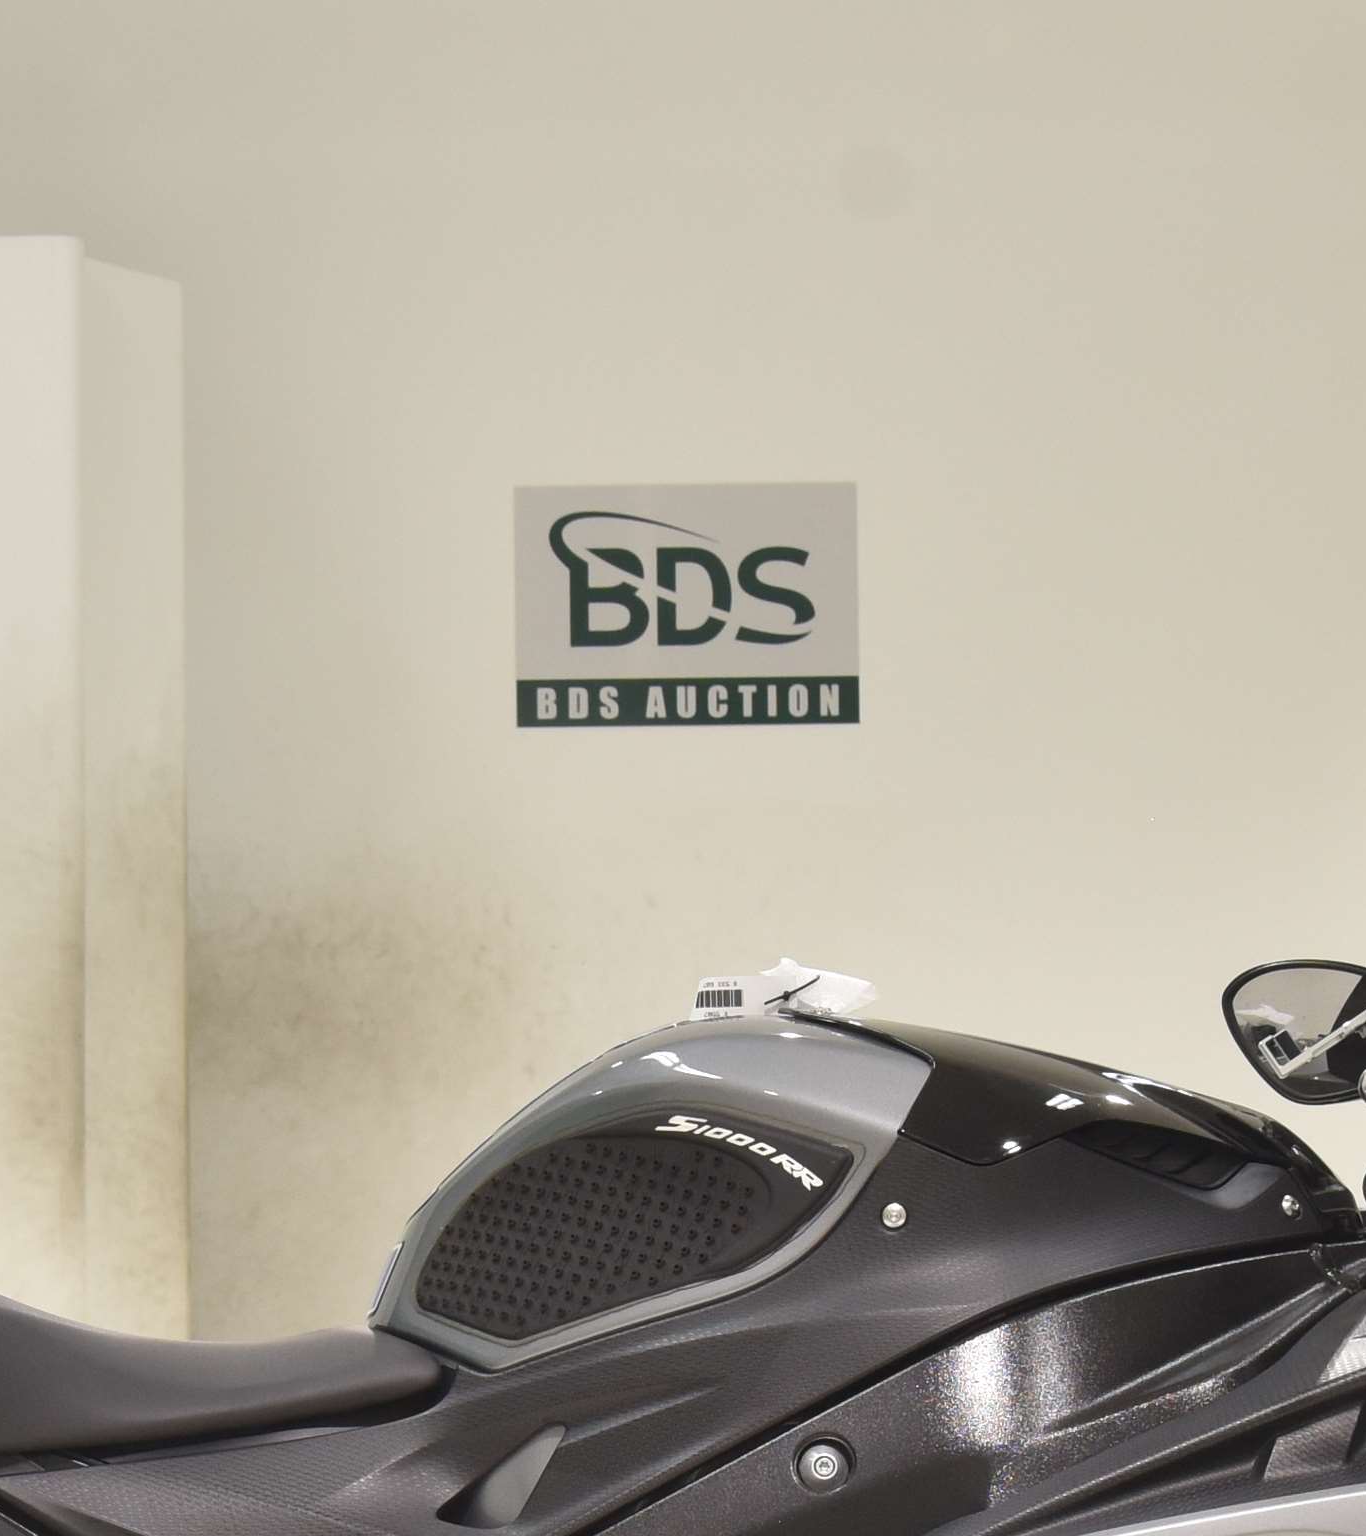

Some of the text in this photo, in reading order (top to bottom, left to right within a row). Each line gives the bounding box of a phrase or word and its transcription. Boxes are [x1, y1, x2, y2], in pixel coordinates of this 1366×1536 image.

[549, 511, 816, 647] BDS
[537, 684, 841, 720] BDS AUCTION
